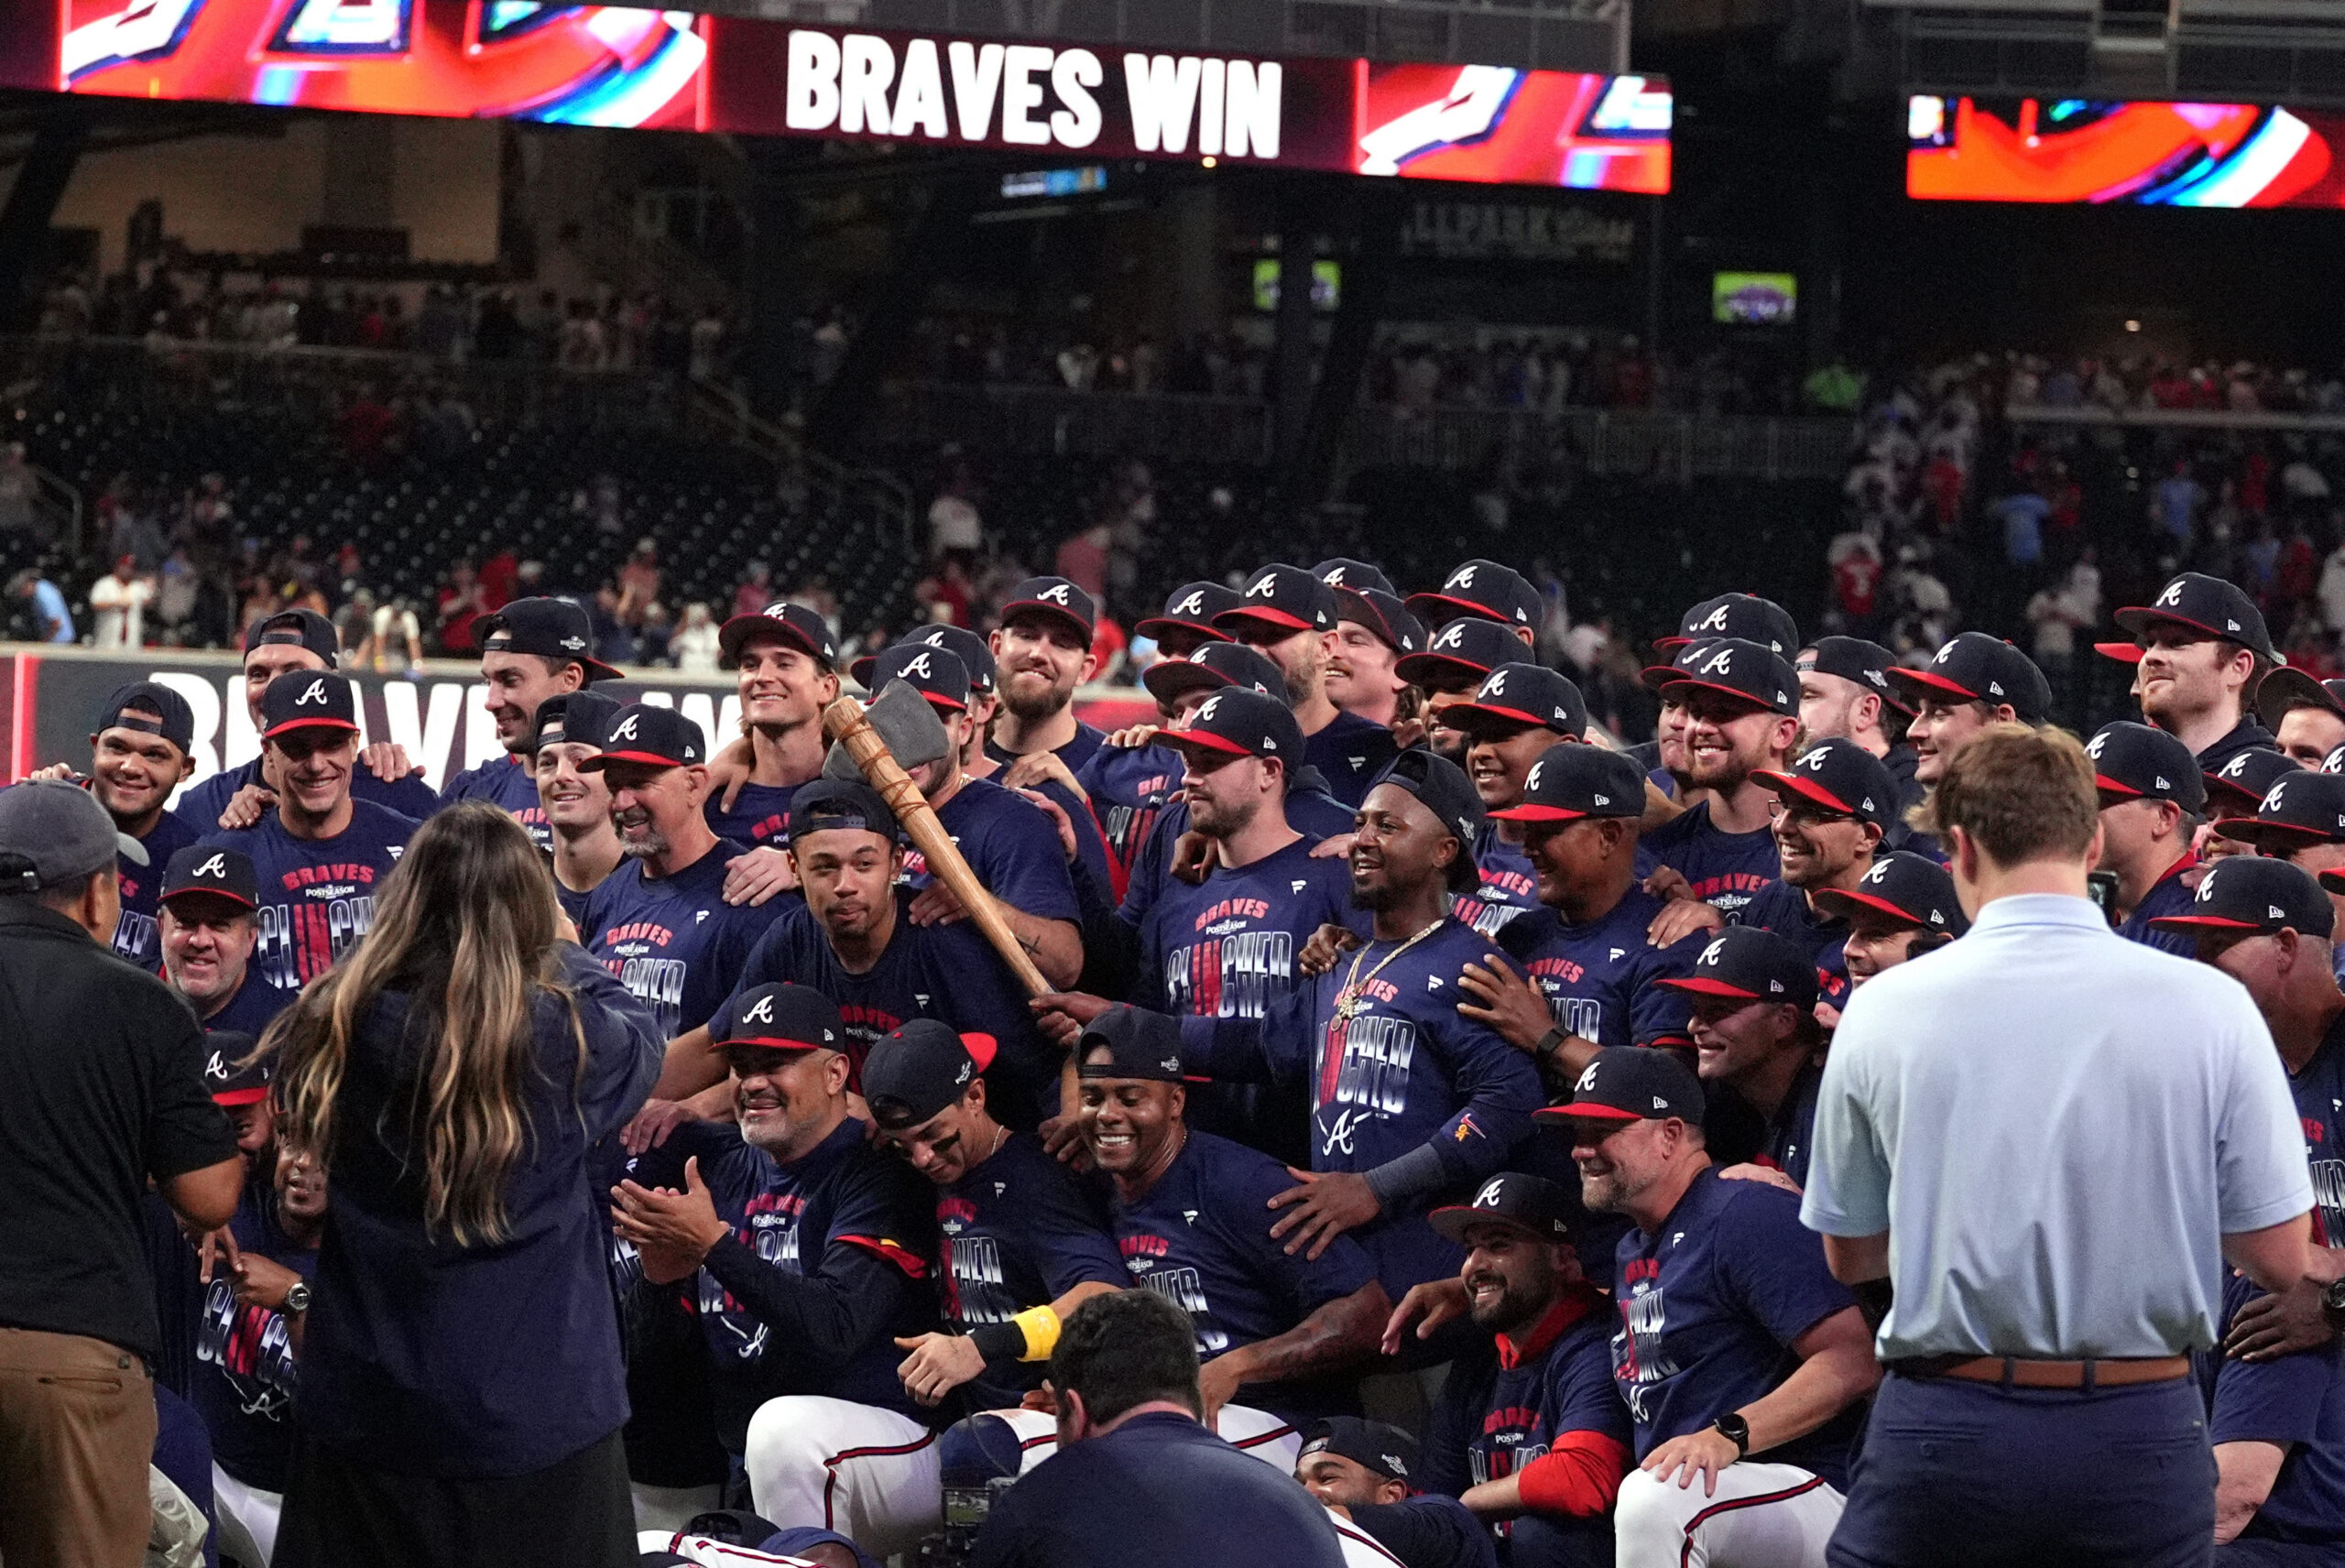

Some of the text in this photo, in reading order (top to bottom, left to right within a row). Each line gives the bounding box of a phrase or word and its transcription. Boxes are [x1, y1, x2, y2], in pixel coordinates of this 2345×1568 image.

[786, 29, 1282, 158] BRAVES WIN
[1246, 573, 1277, 597] A
[1445, 566, 1478, 589] A
[1037, 584, 1069, 605] A
[1172, 591, 1204, 615] A
[2156, 581, 2186, 606] A
[1700, 604, 1729, 630] A
[1434, 624, 1466, 649] A
[1700, 649, 1733, 674] A
[1932, 639, 1958, 664] A
[898, 653, 931, 679] A
[296, 679, 327, 705] A
[1478, 670, 1508, 698] A
[1193, 695, 1222, 722] A
[609, 714, 638, 742] A
[1795, 746, 1832, 770] A
[2085, 733, 2110, 760] A
[2319, 746, 2345, 773] A
[1524, 761, 1543, 790] A
[2218, 753, 2252, 778] A
[2259, 782, 2286, 812] A
[192, 854, 225, 877] A
[282, 864, 375, 890] BRAVES
[1860, 859, 1893, 883] A
[305, 885, 355, 898] POSTSEASON
[2195, 869, 2218, 902] A
[1195, 898, 1270, 931] BRAVES
[1205, 920, 1247, 935] POSTSEASON
[606, 922, 673, 947] BRAVES
[1697, 938, 1726, 965] A
[743, 996, 773, 1023] A
[205, 1051, 227, 1079] A
[1575, 1062, 1600, 1092] A
[1473, 1179, 1504, 1208] A
